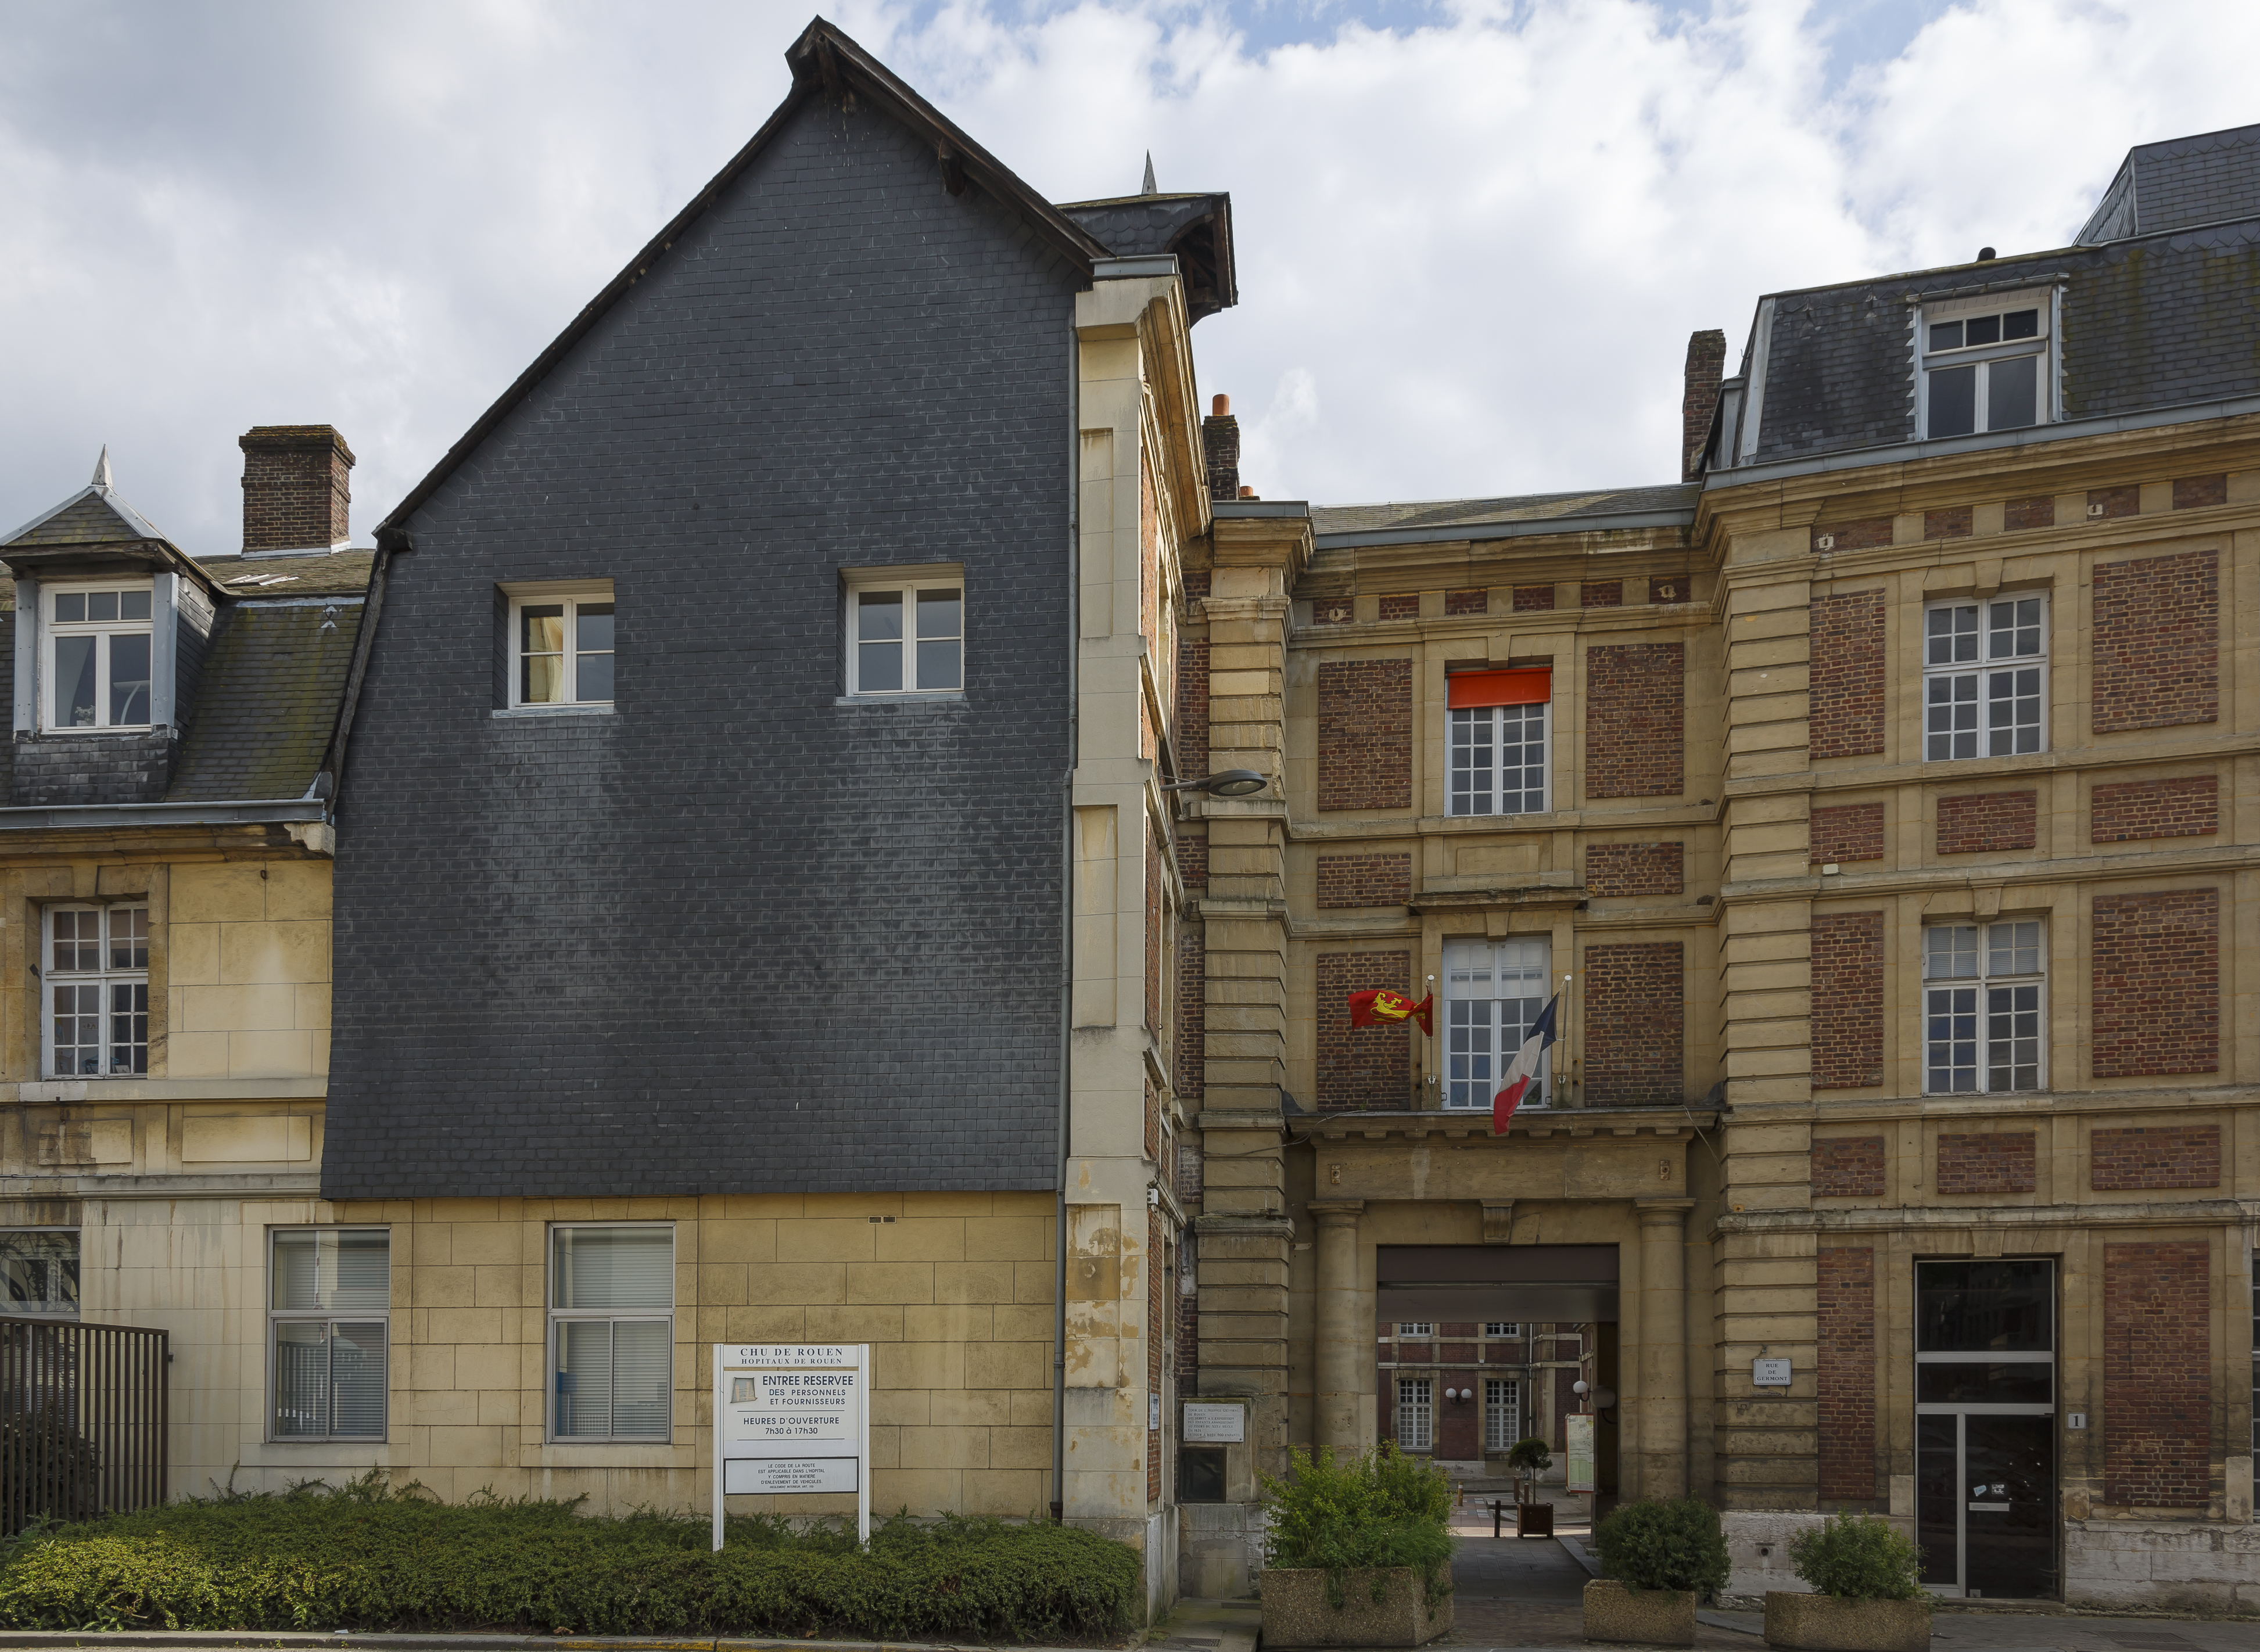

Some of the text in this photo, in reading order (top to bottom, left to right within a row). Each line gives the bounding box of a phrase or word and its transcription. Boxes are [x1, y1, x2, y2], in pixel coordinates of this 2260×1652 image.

[740, 1348, 843, 1356] CHU DE ROUEN
[762, 1376, 853, 1385] ENTREE RESERVEE
[2073, 1415, 2080, 1427] 1
